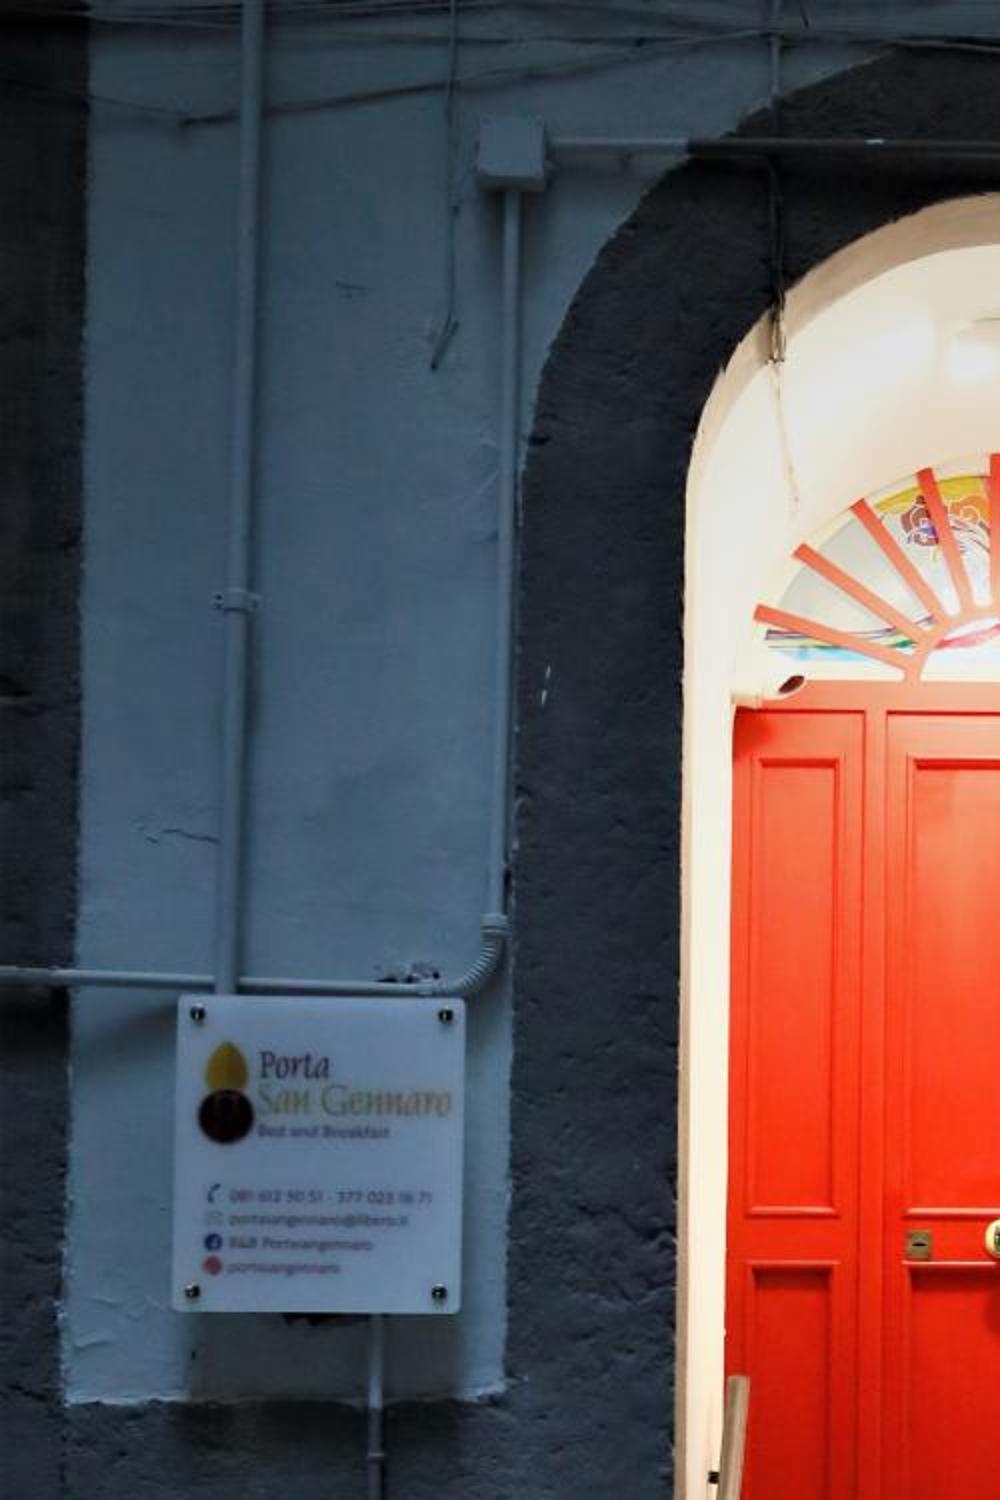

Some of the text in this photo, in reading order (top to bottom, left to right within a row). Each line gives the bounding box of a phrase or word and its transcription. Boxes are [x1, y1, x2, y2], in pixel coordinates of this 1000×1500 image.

[259, 1051, 330, 1079] Porta
[257, 1084, 453, 1117] San Gennaro
[289, 1124, 319, 1138] and
